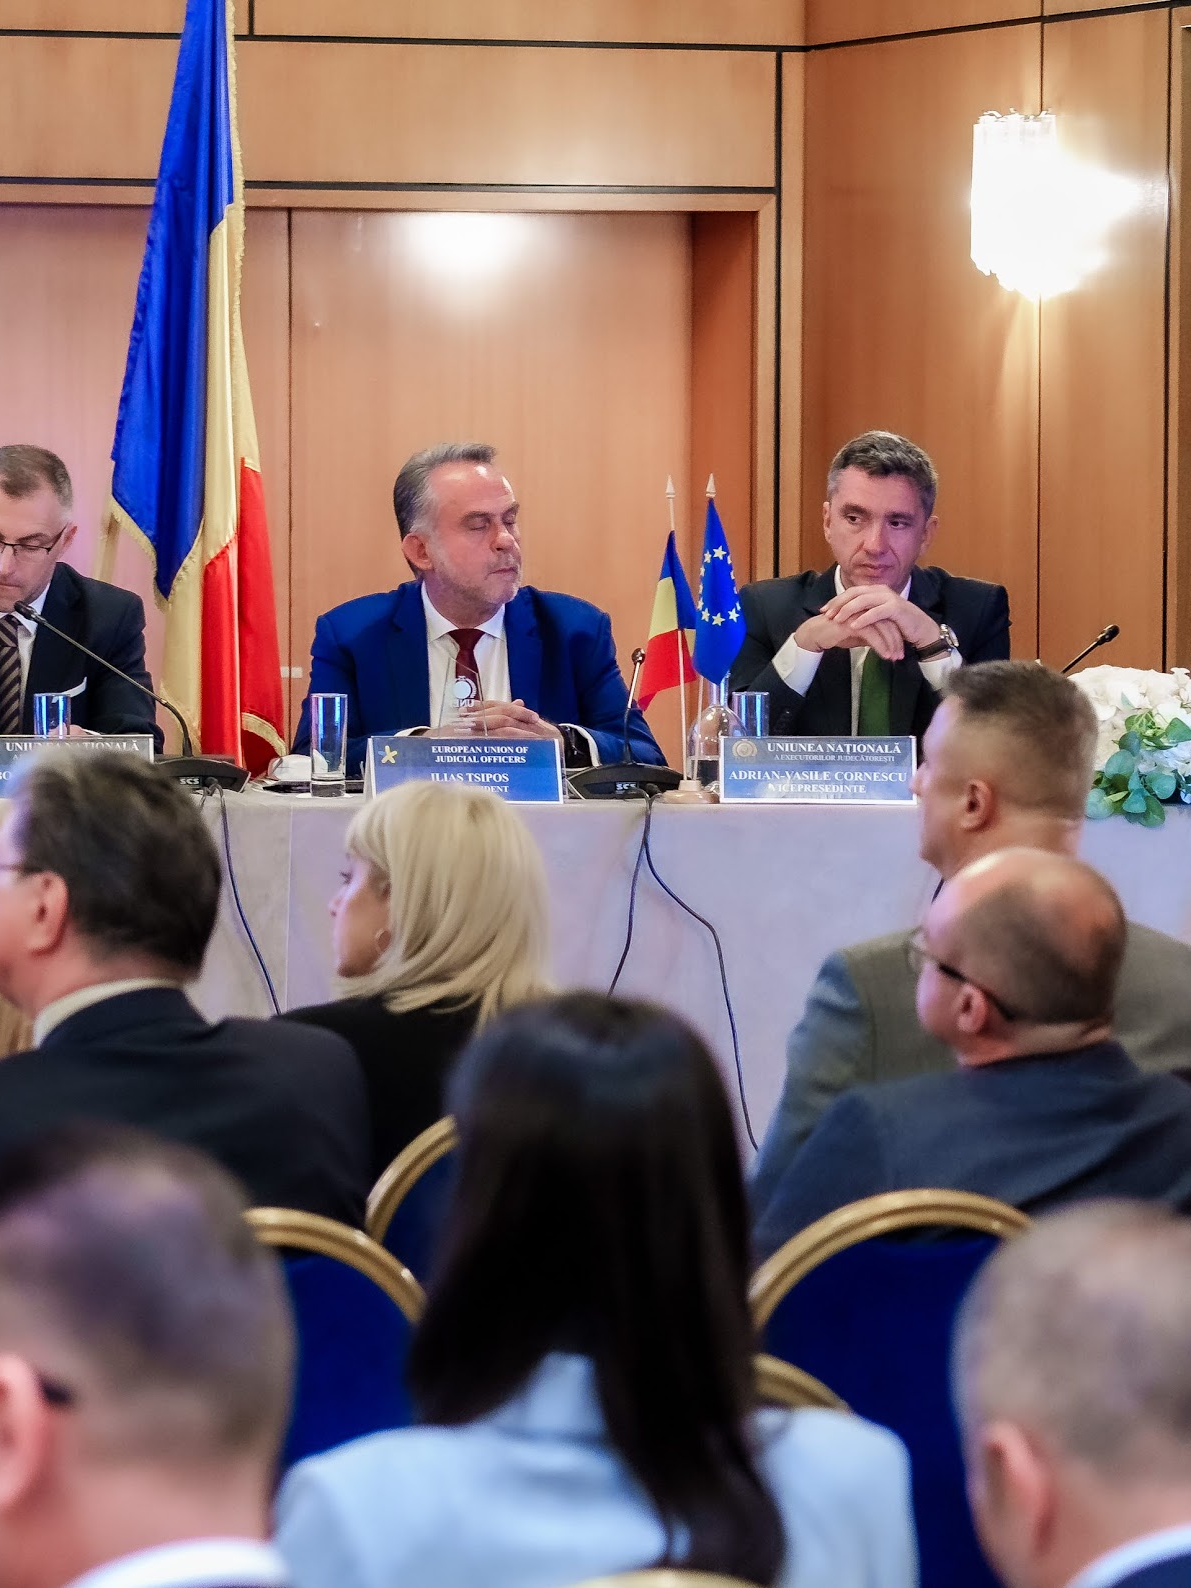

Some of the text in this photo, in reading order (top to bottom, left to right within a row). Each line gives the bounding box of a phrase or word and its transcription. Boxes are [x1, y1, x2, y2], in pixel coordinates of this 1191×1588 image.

[431, 746, 528, 754] EUROPEAN UNION OF
[767, 743, 824, 753] UNIUNEA
[434, 756, 526, 764] JUDICIAL OFFICERS
[779, 754, 836, 762] EXECUTORILOR
[430, 772, 509, 783] ILIAS TSIPOS
[729, 770, 907, 782] ADRIAN-VASILE CORNESCU
